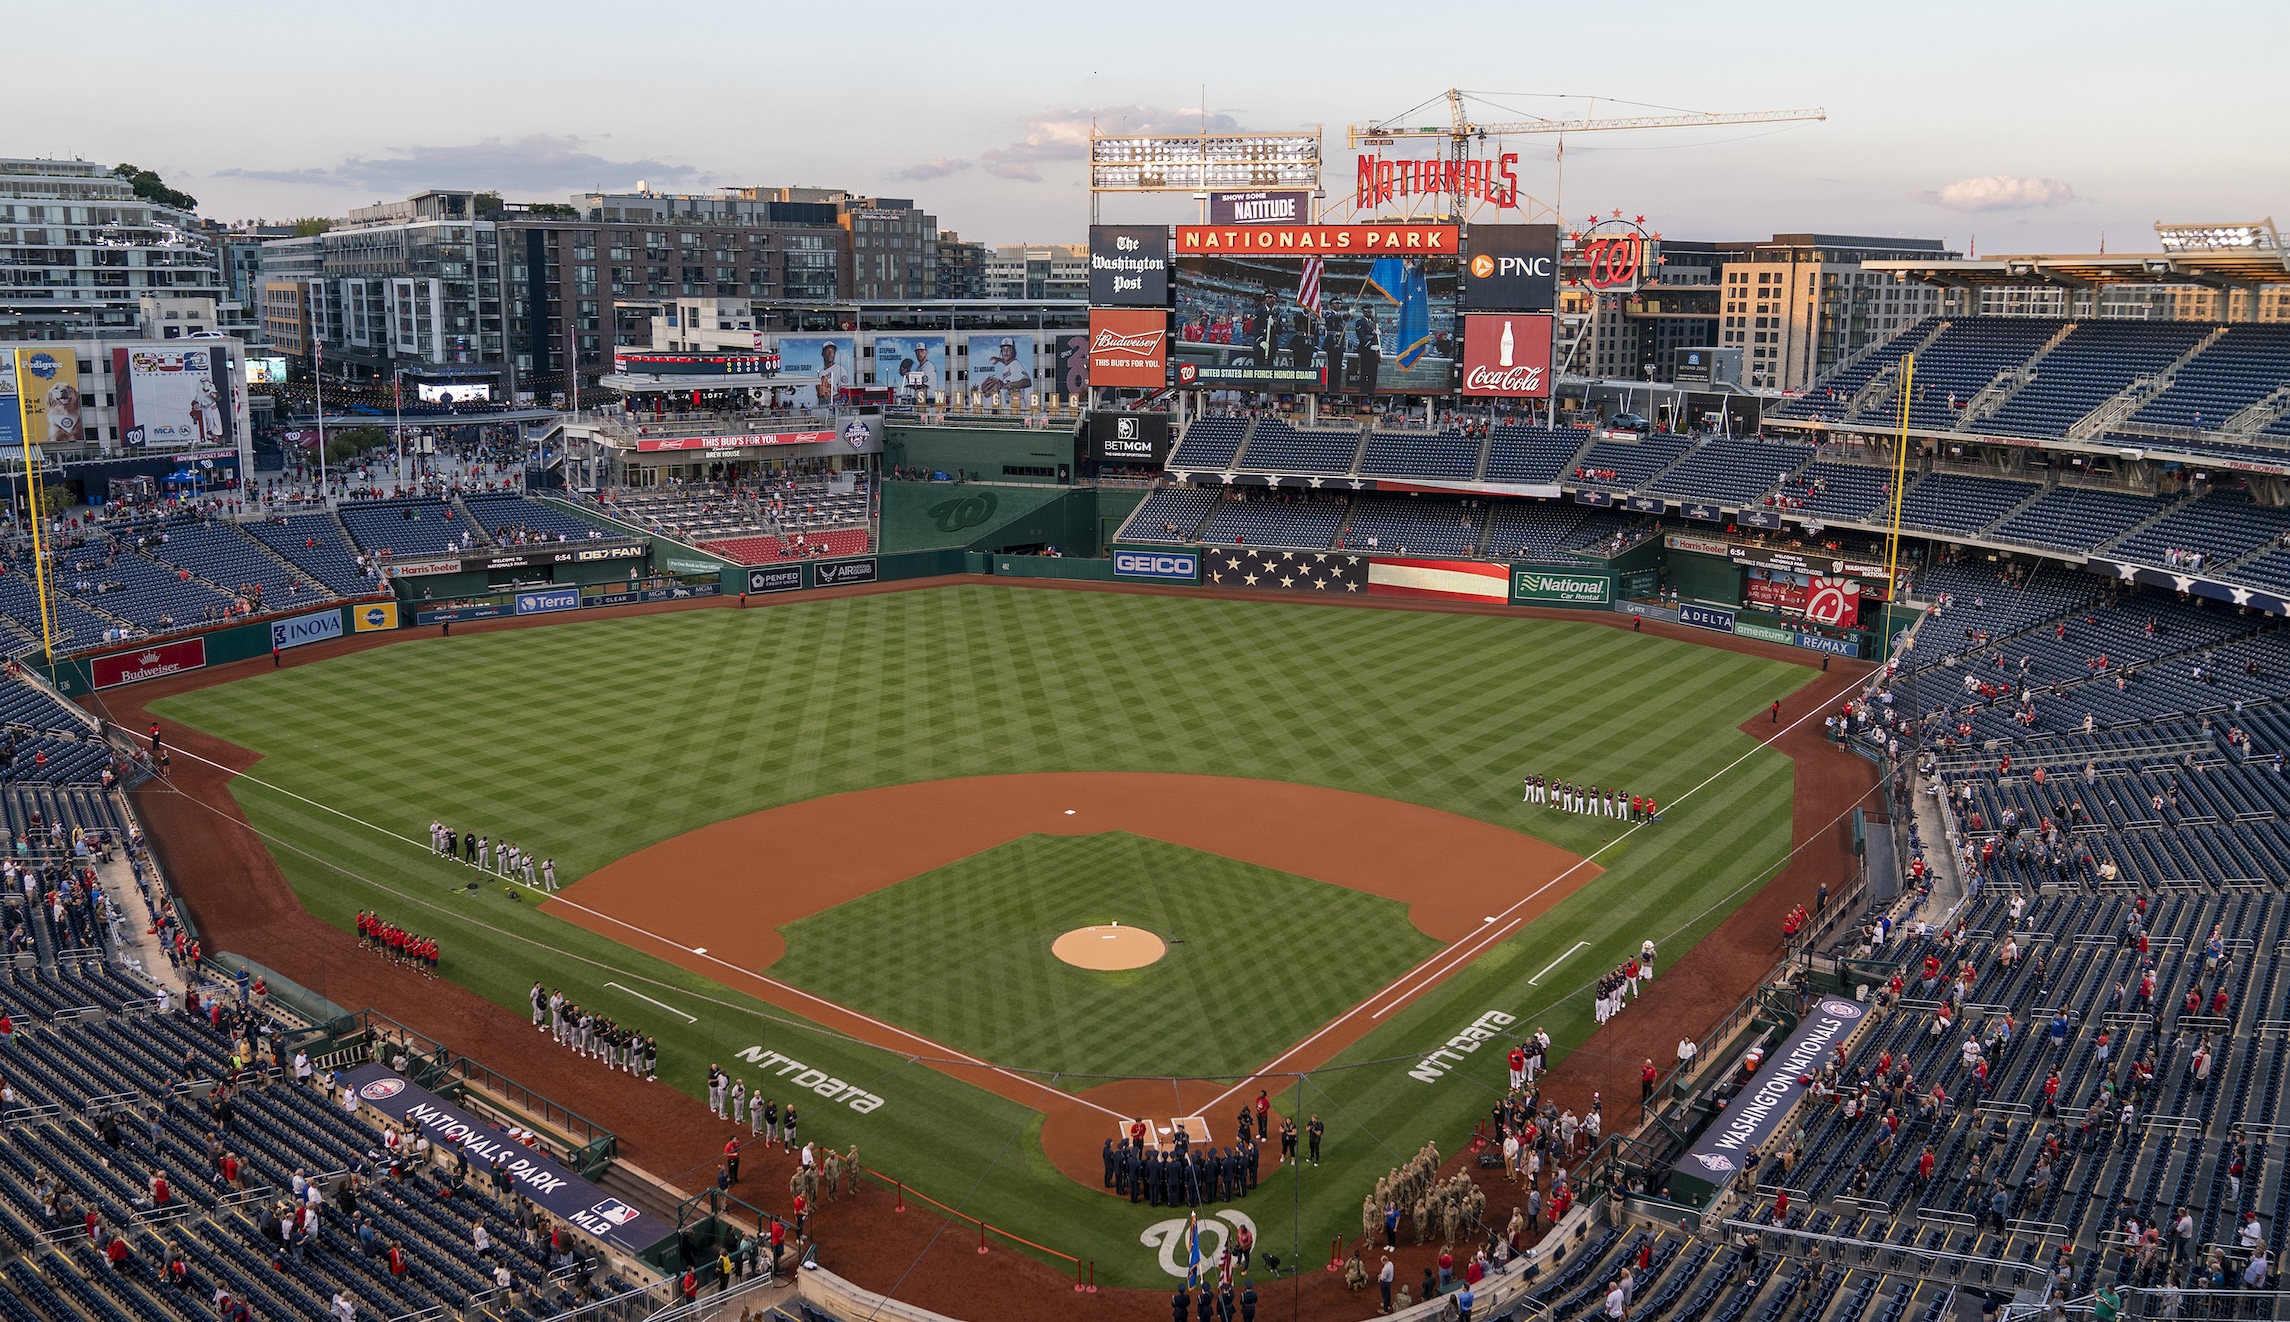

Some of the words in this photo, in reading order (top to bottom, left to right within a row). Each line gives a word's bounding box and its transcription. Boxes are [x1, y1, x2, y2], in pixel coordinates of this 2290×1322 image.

[1357, 153, 1518, 208] NATIONALS
[1234, 198, 1296, 220] NATITUDE
[1117, 236, 1140, 252] The
[1186, 232, 1350, 248] NATIONALS
[1367, 232, 1442, 248] PARK
[1092, 253, 1164, 273] Washington
[1498, 257, 1550, 276] PNC
[1113, 276, 1142, 293] Post
[1096, 334, 1157, 347] Budweiser
[785, 364, 800, 372] JOSIAH
[1095, 358, 1110, 366] THIS
[1111, 359, 1130, 367] BUD'S
[1146, 360, 1160, 368] YOU.
[1198, 368, 1220, 377] UNITED
[1220, 369, 1242, 378] STATES
[1243, 369, 1253, 378] AIR
[1254, 370, 1273, 379] FORCE
[1274, 370, 1295, 380] HONOR
[1296, 371, 1316, 380] GUARD
[701, 438, 720, 447] THIS
[721, 436, 744, 446] BUD'S
[746, 436, 760, 444] FOR
[761, 435, 779, 444] YOU.
[1105, 441, 1152, 451] BETMGM
[2230, 462, 2252, 470] FRANK
[2254, 464, 2285, 474] HOWARD
[612, 547, 641, 557] FAN
[1680, 540, 1702, 550] Harris
[1702, 542, 1726, 554] Teeter
[554, 553, 571, 561] 6:54
[1733, 558, 1755, 566] NATIONALS
[1770, 558, 1793, 566] NATIONALS
[401, 565, 428, 575] Harris
[429, 563, 458, 572] Teeter
[838, 566, 853, 576] AIR
[1117, 556, 1193, 574] GEICO
[766, 572, 798, 582] PENFED
[695, 585, 713, 593] MGM
[537, 594, 575, 608] Terra
[1693, 610, 1731, 627] DELTA
[291, 616, 340, 639] INOVA
[1738, 625, 1784, 641] amentum
[1803, 636, 1848, 654] RE/MAX
[1849, 633, 1858, 643] 335
[121, 662, 180, 682] Budweiser
[60, 681, 70, 691] 336
[1715, 1072, 1793, 1150] WASHINGTON
[1785, 1016, 1842, 1076] NATIONALS
[406, 1102, 513, 1164] NATIONALS
[508, 1158, 568, 1195] PARK
[568, 1209, 612, 1236] MLB
